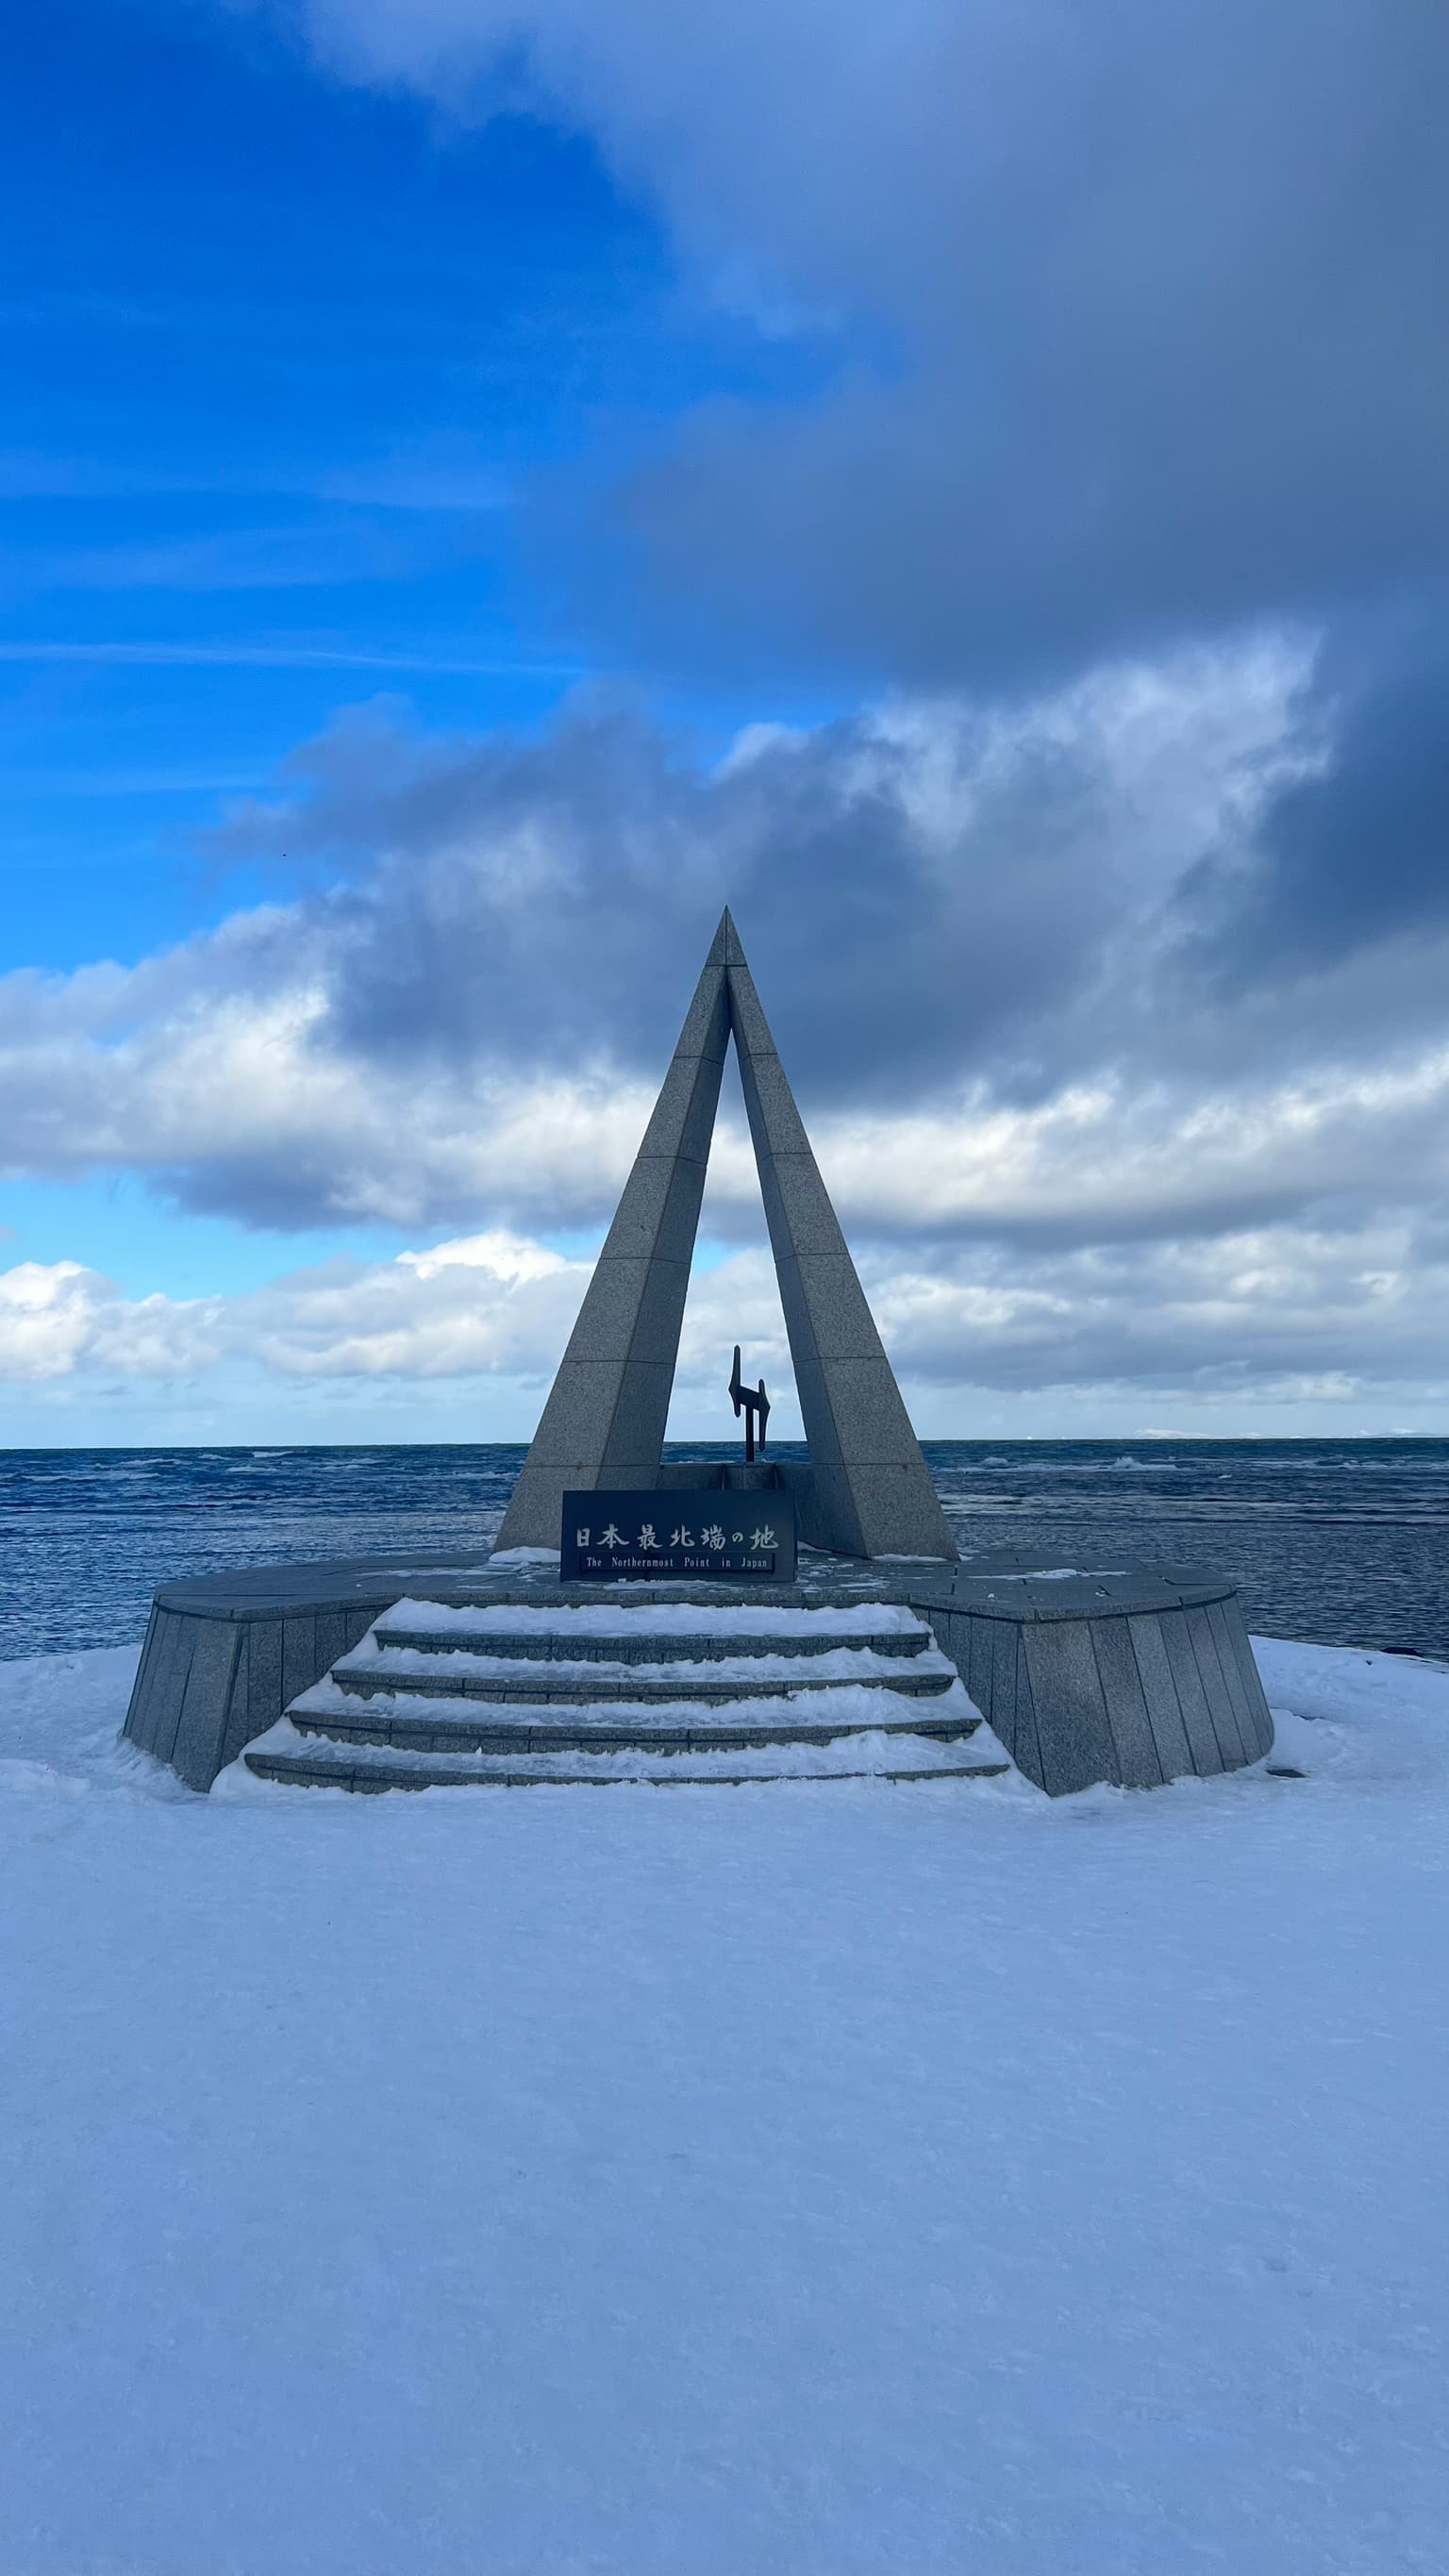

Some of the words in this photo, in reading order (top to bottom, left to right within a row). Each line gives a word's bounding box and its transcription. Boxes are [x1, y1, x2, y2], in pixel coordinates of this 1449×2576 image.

[576, 1523, 780, 1551] 日本最北端の地
[587, 1556, 602, 1568] The
[611, 1556, 674, 1568] Northernmost
[684, 1556, 709, 1568] Point
[722, 1556, 731, 1568] in
[741, 1556, 767, 1570] Japan
